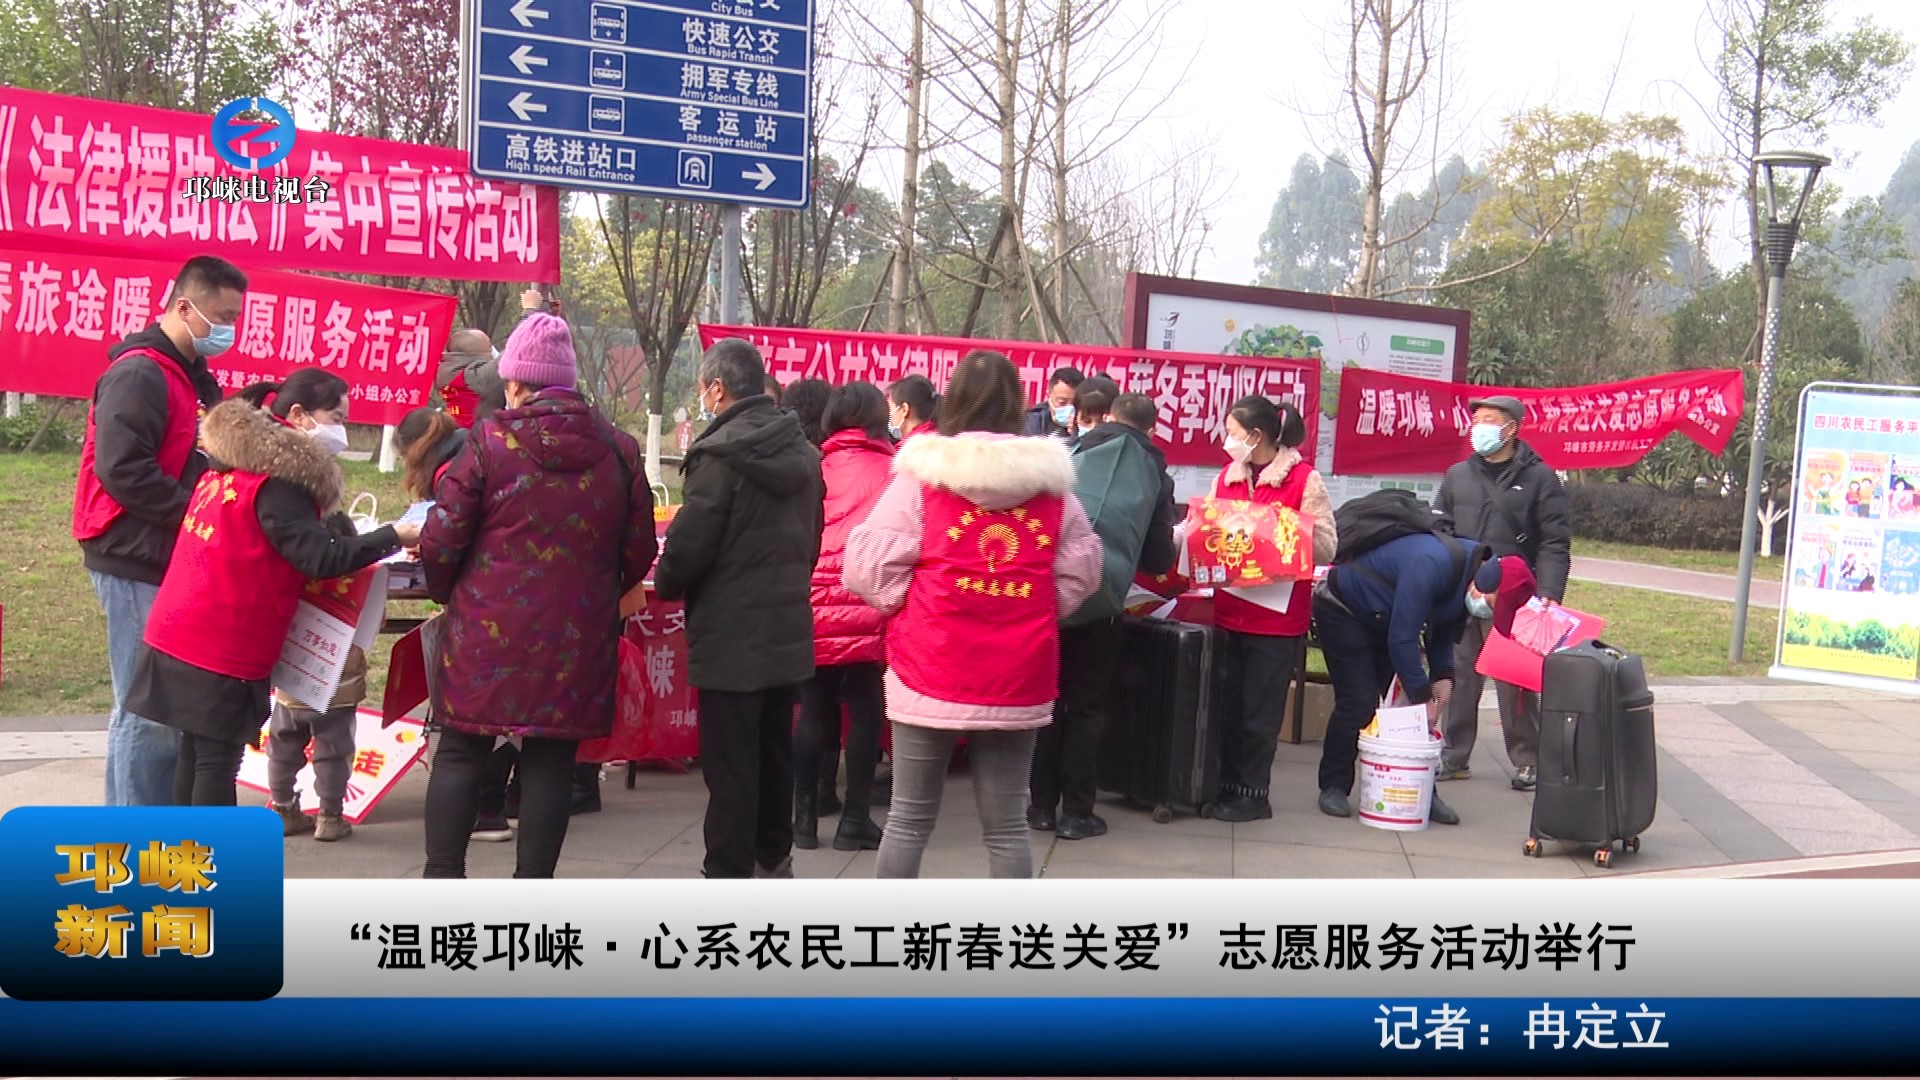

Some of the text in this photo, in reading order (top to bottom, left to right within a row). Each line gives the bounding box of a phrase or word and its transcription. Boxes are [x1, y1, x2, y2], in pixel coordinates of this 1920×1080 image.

[711, 2, 732, 14] City
[734, 5, 754, 17] Bus
[682, 17, 780, 55] 快速公交
[687, 43, 774, 64] Bus Rapid Transit
[681, 62, 779, 98] 拥军专线
[680, 88, 779, 110] Army Special Bus Line
[678, 105, 778, 142] 客运站
[506, 133, 636, 171] 高铁进站口
[686, 133, 768, 151] passenger station
[505, 159, 636, 182] High speed Rail Entrance
